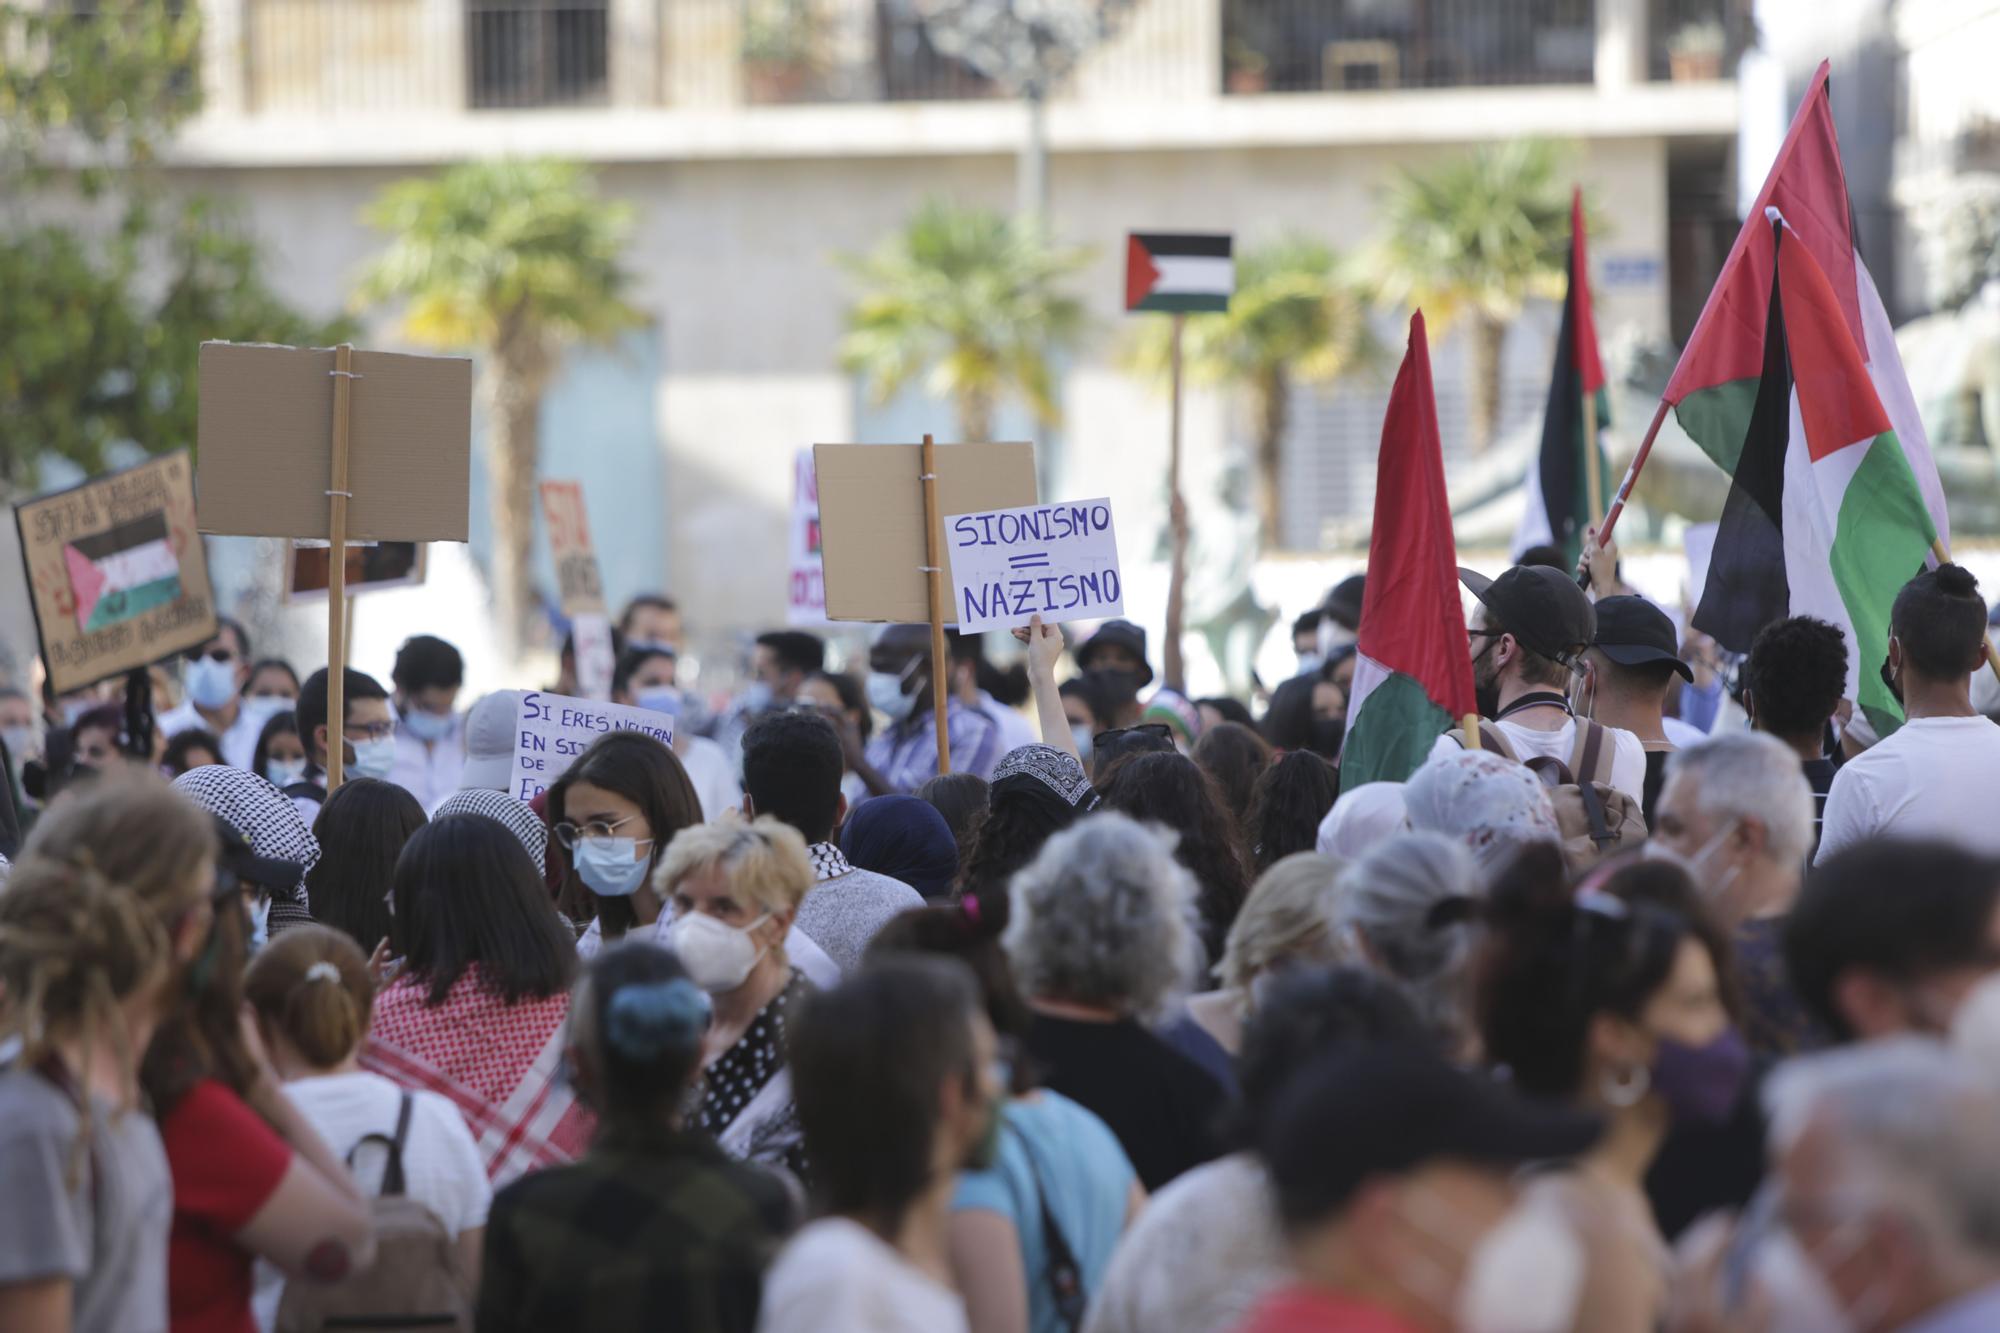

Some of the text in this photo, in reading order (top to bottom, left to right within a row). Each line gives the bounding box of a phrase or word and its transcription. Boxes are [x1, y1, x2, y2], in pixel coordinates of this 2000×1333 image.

[955, 506, 1109, 547] SIONISMO
[964, 569, 1120, 623] NAZISMO
[561, 709, 610, 732] ERES
[521, 731, 546, 752] EN
[521, 756, 545, 771] DE
